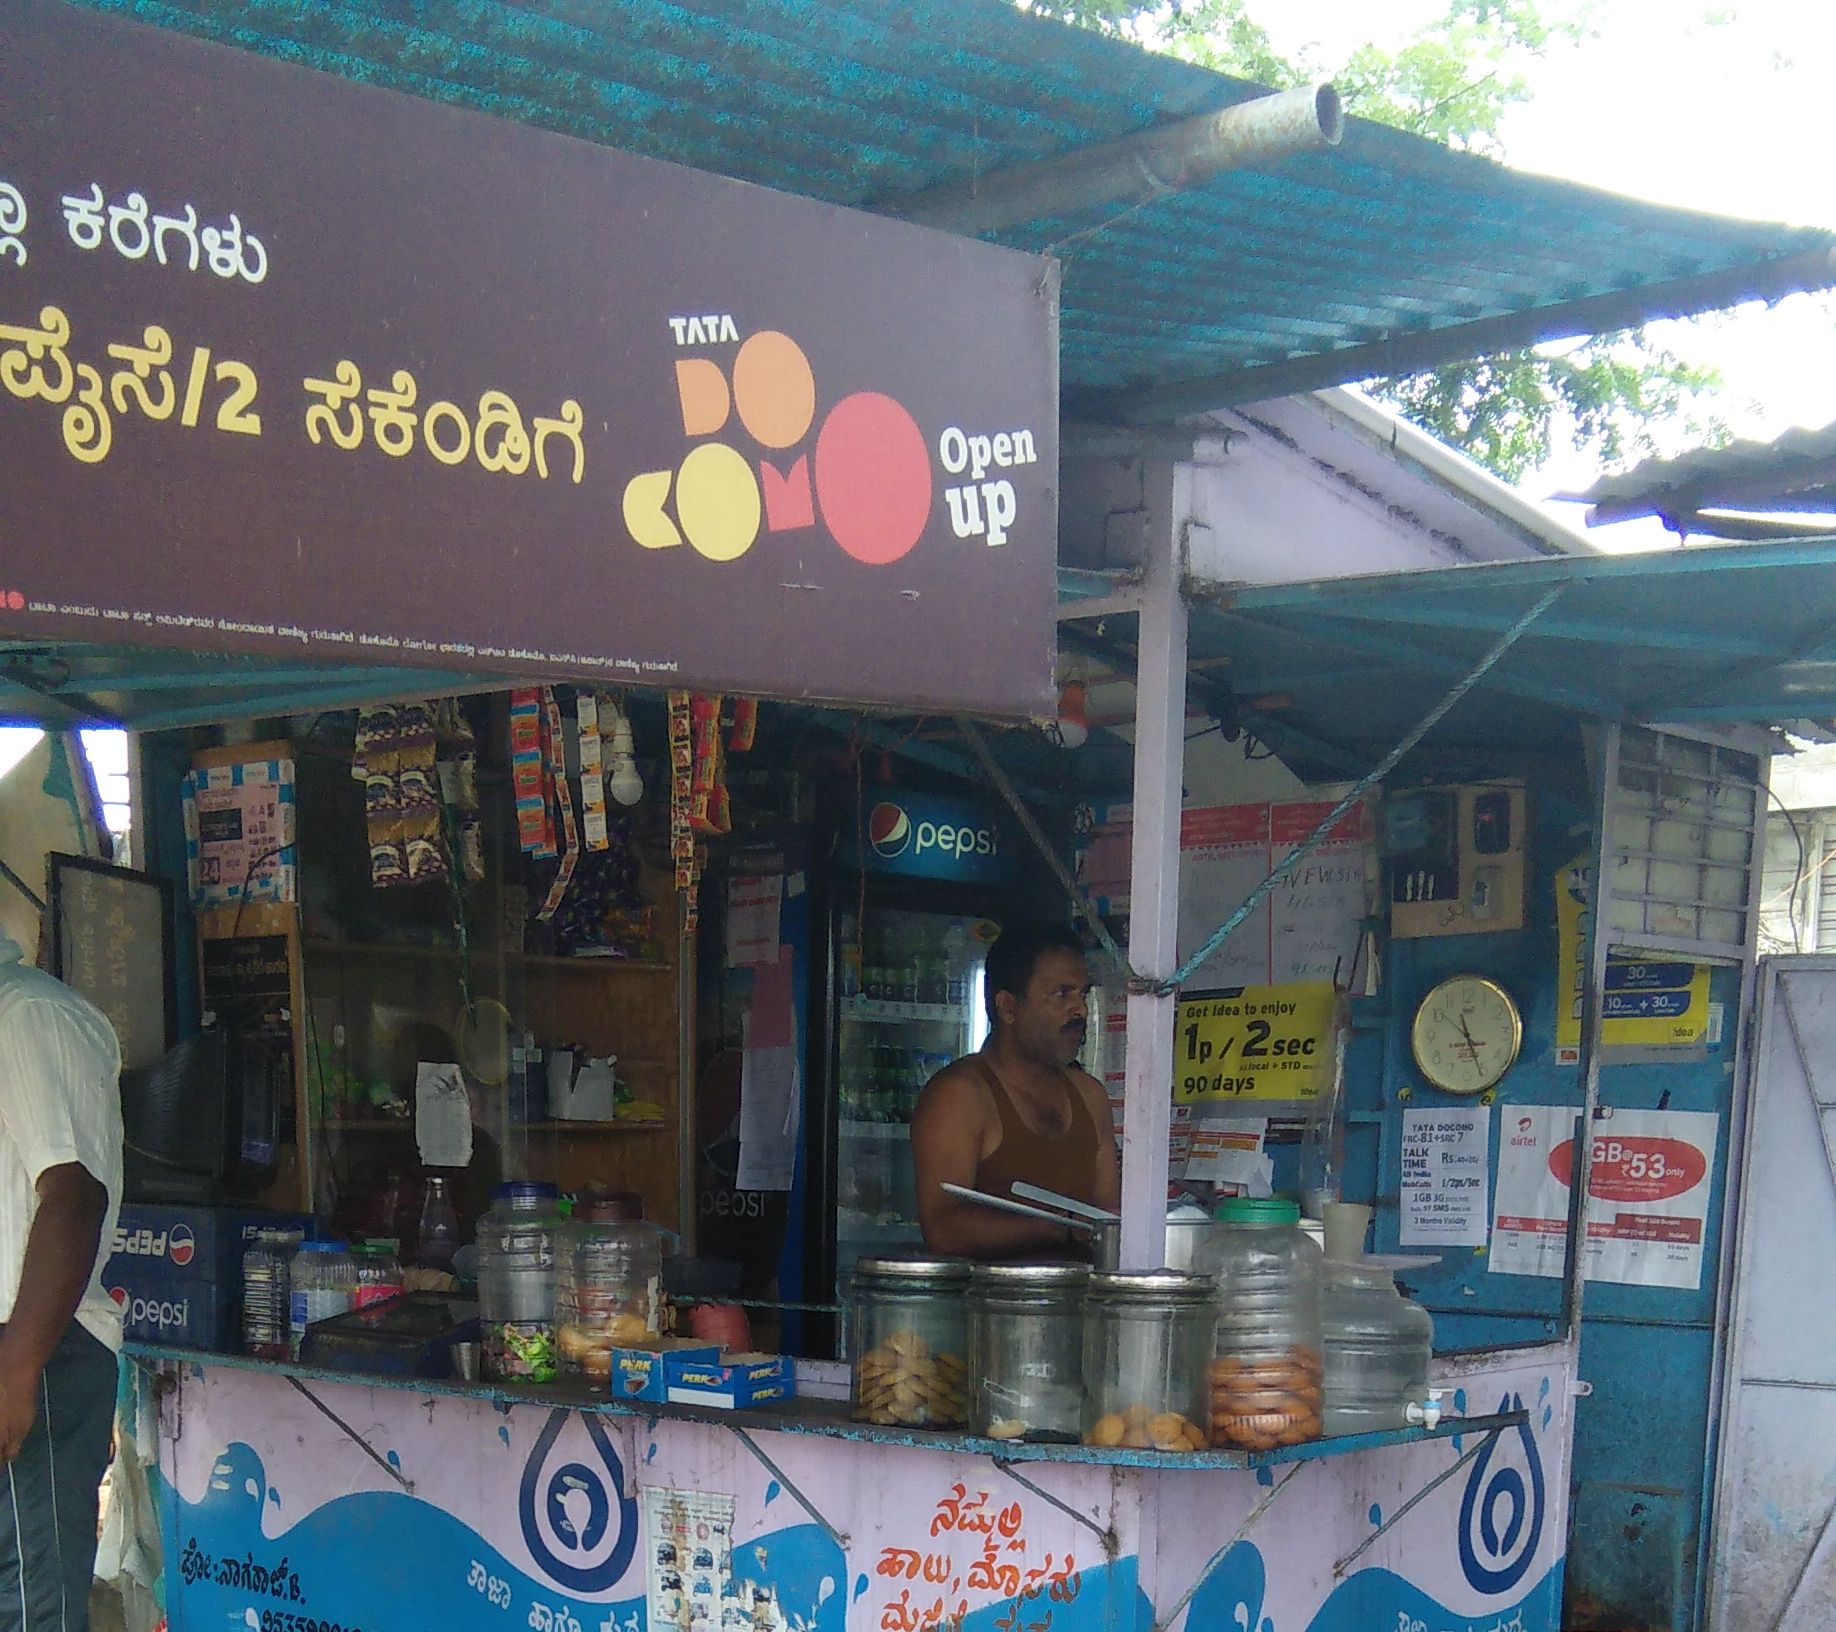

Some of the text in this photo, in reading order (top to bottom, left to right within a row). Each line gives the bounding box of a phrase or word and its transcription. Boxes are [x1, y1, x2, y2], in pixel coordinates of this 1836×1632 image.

[61, 182, 268, 283] ಕರೆಗಳು
[669, 314, 740, 346] TATA
[0, 305, 586, 483] ಪೈಸೆ/2 ಸೆಕೆಂಡಿಗೆ
[939, 425, 1038, 482] Open
[945, 478, 1018, 547] up
[915, 821, 997, 860] pepsi
[1627, 966, 1646, 980] 30
[1186, 1001, 1297, 1019] Get Idea to enjoy
[1652, 996, 1668, 1009] 30
[1184, 1073, 1256, 1095] 90 days
[1412, 1123, 1474, 1132] TATA DOCOMO
[1511, 1136, 1537, 1147] airtel
[1403, 1148, 1429, 1157] TALK
[1403, 1159, 1427, 1168] TIME
[111, 1228, 167, 1258] PEPS
[131, 1298, 190, 1330] pepsi
[619, 1358, 652, 1372] PERK
[749, 1367, 772, 1381] PERK
[681, 1373, 708, 1384] PERK
[752, 1387, 775, 1401] PERK
[466, 1558, 513, 1610] ತಾಜಾ
